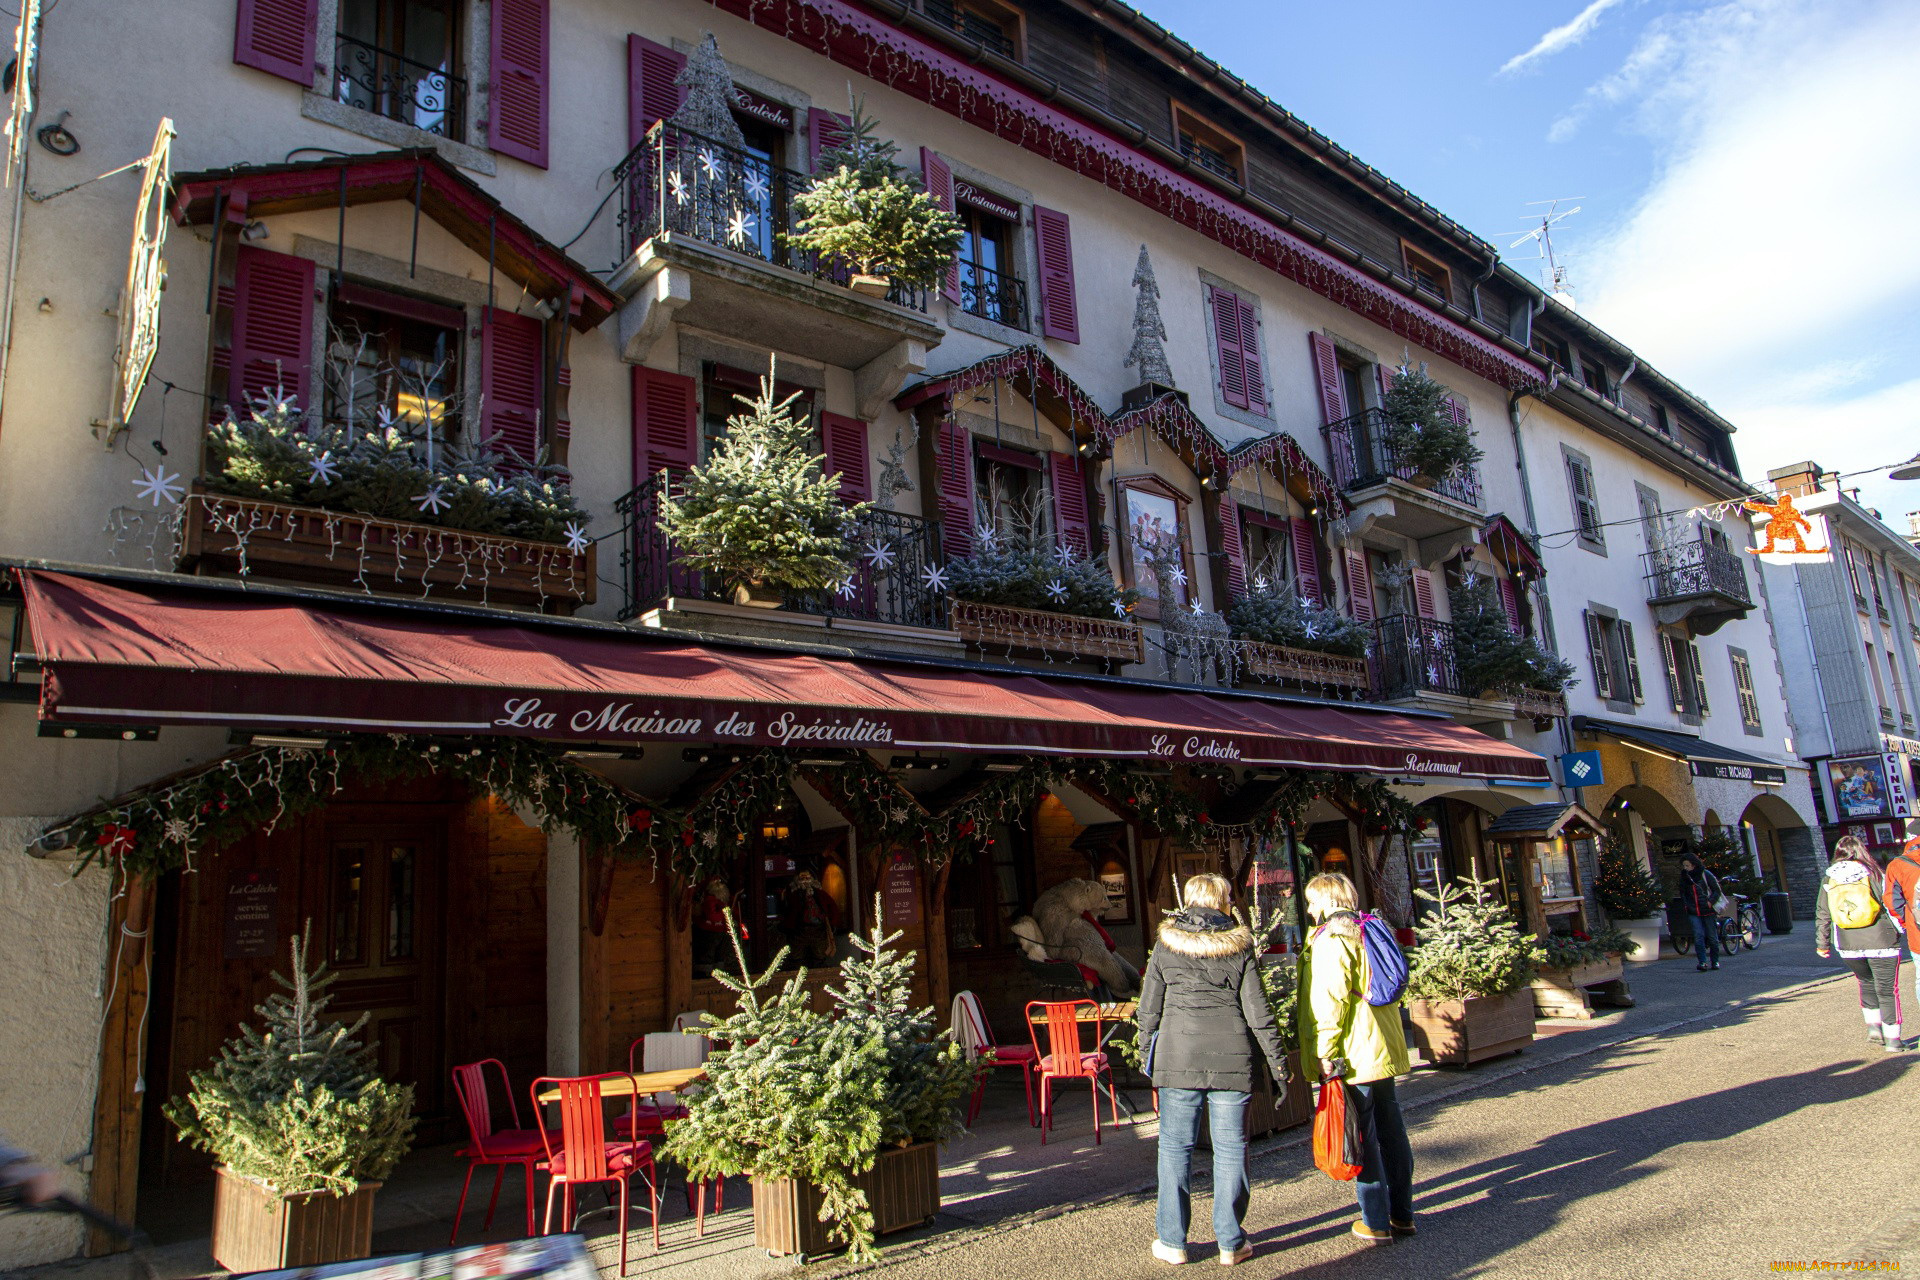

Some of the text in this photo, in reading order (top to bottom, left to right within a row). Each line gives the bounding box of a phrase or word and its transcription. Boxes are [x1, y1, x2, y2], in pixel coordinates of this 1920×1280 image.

[733, 87, 789, 126] Calèche
[954, 181, 1019, 221] Restaurant
[494, 697, 893, 746] La Maison des Spécialités
[1148, 733, 1241, 761] La Calèche
[1403, 753, 1462, 775] Restaurant
[1715, 766, 1727, 778] CHEZ
[1728, 765, 1752, 780] RICHARD
[1887, 755, 1908, 815] CINEMA
[229, 884, 242, 895] La
[890, 886, 912, 894] continu
[235, 912, 270, 921] continu
[238, 903, 268, 912] service
